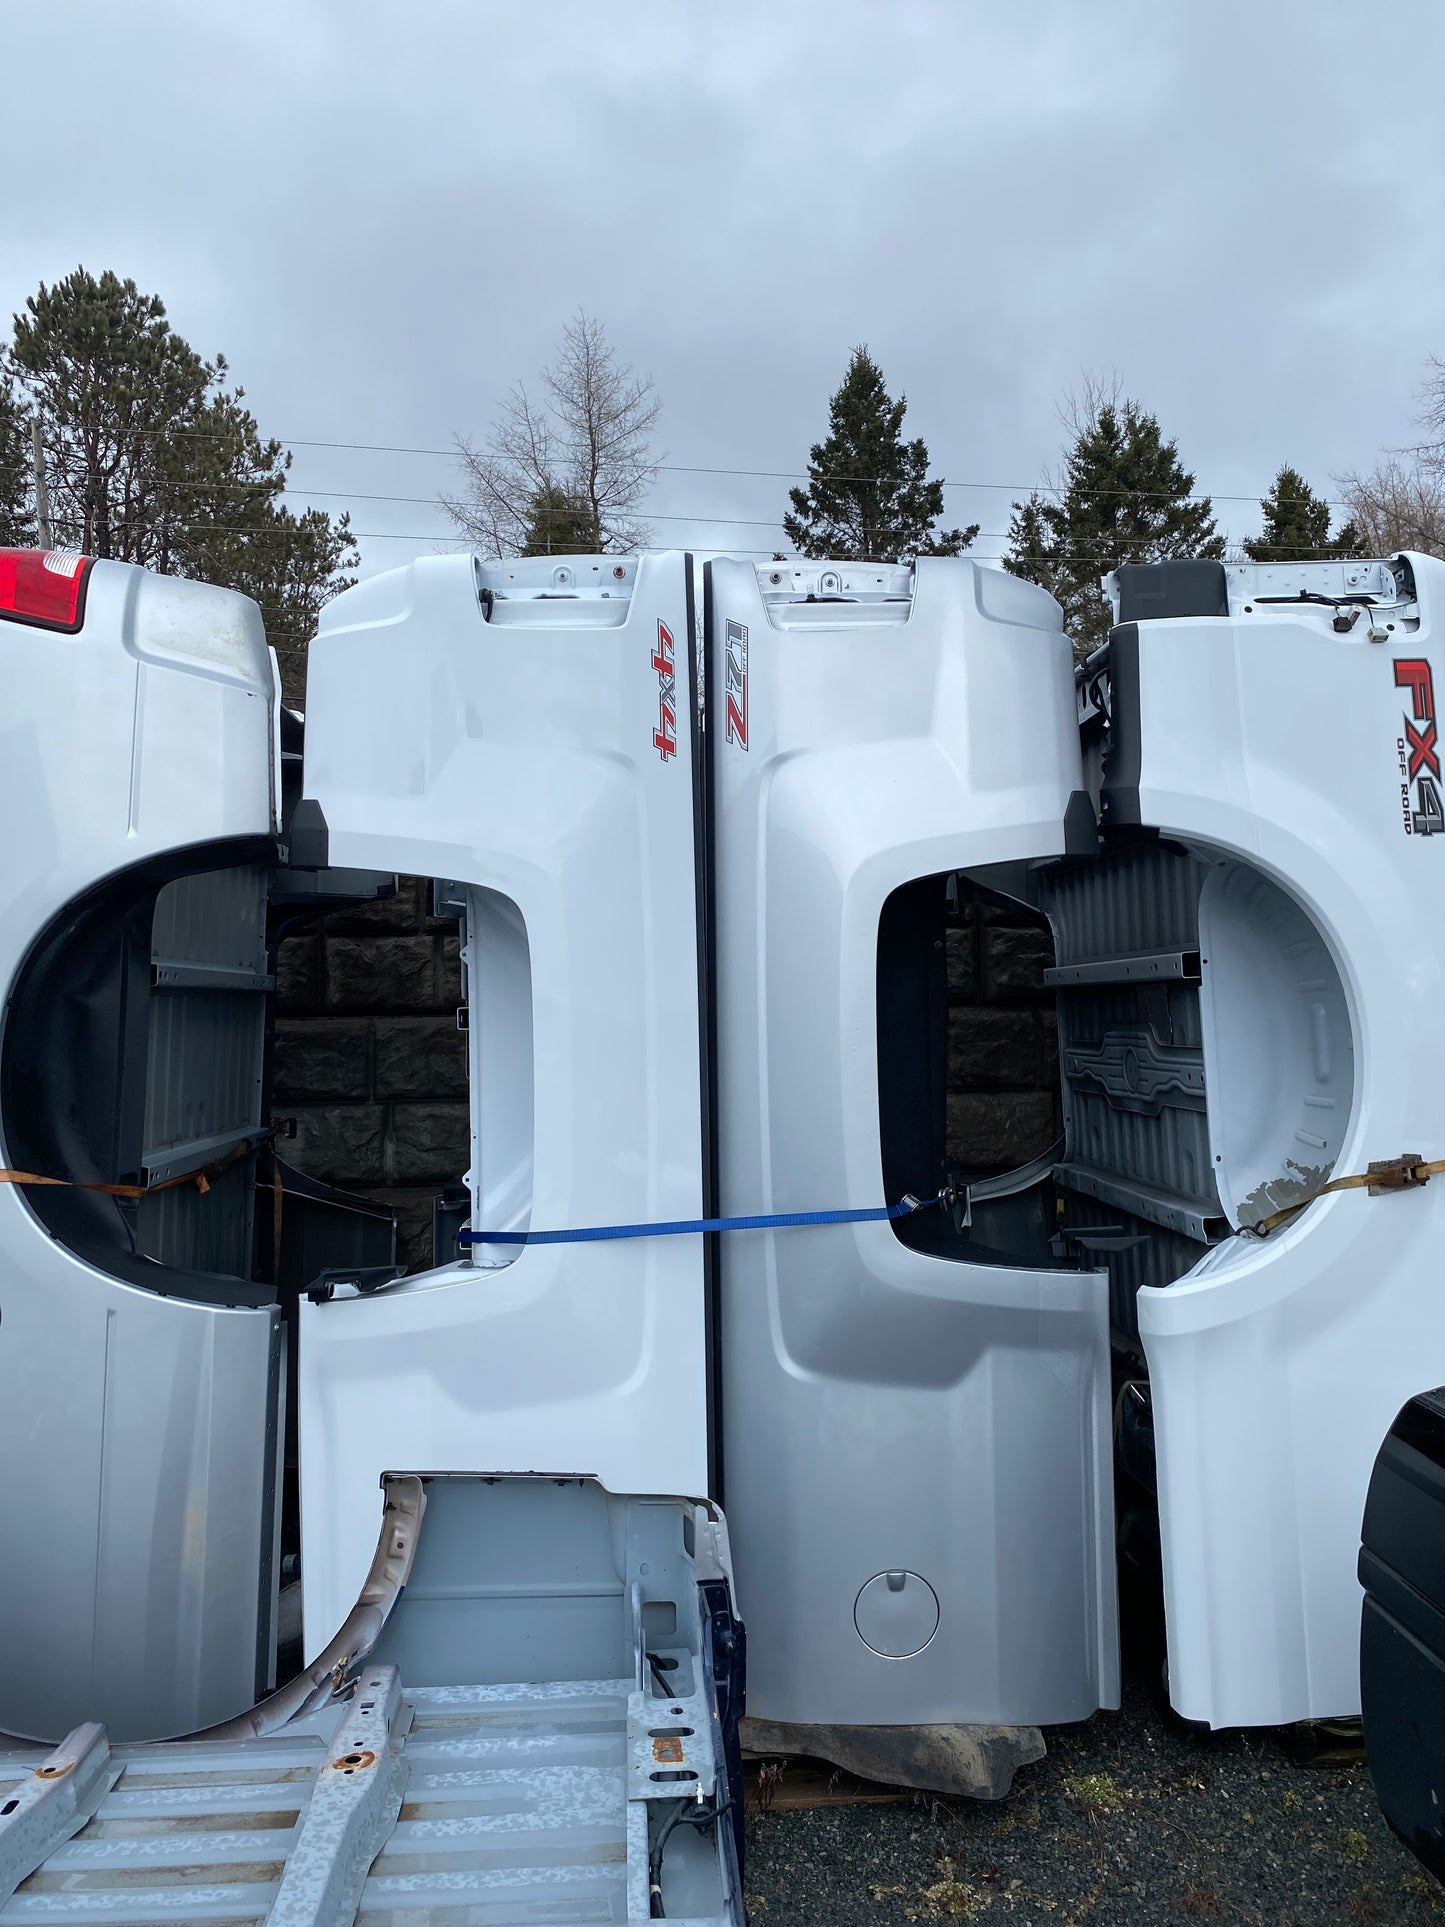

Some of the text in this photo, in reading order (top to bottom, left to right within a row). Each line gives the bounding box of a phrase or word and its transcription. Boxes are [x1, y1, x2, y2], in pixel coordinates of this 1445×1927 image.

[725, 618, 748, 751] Z71
[1391, 658, 1445, 837] FX4
[1397, 737, 1412, 835] OFF ROAD
